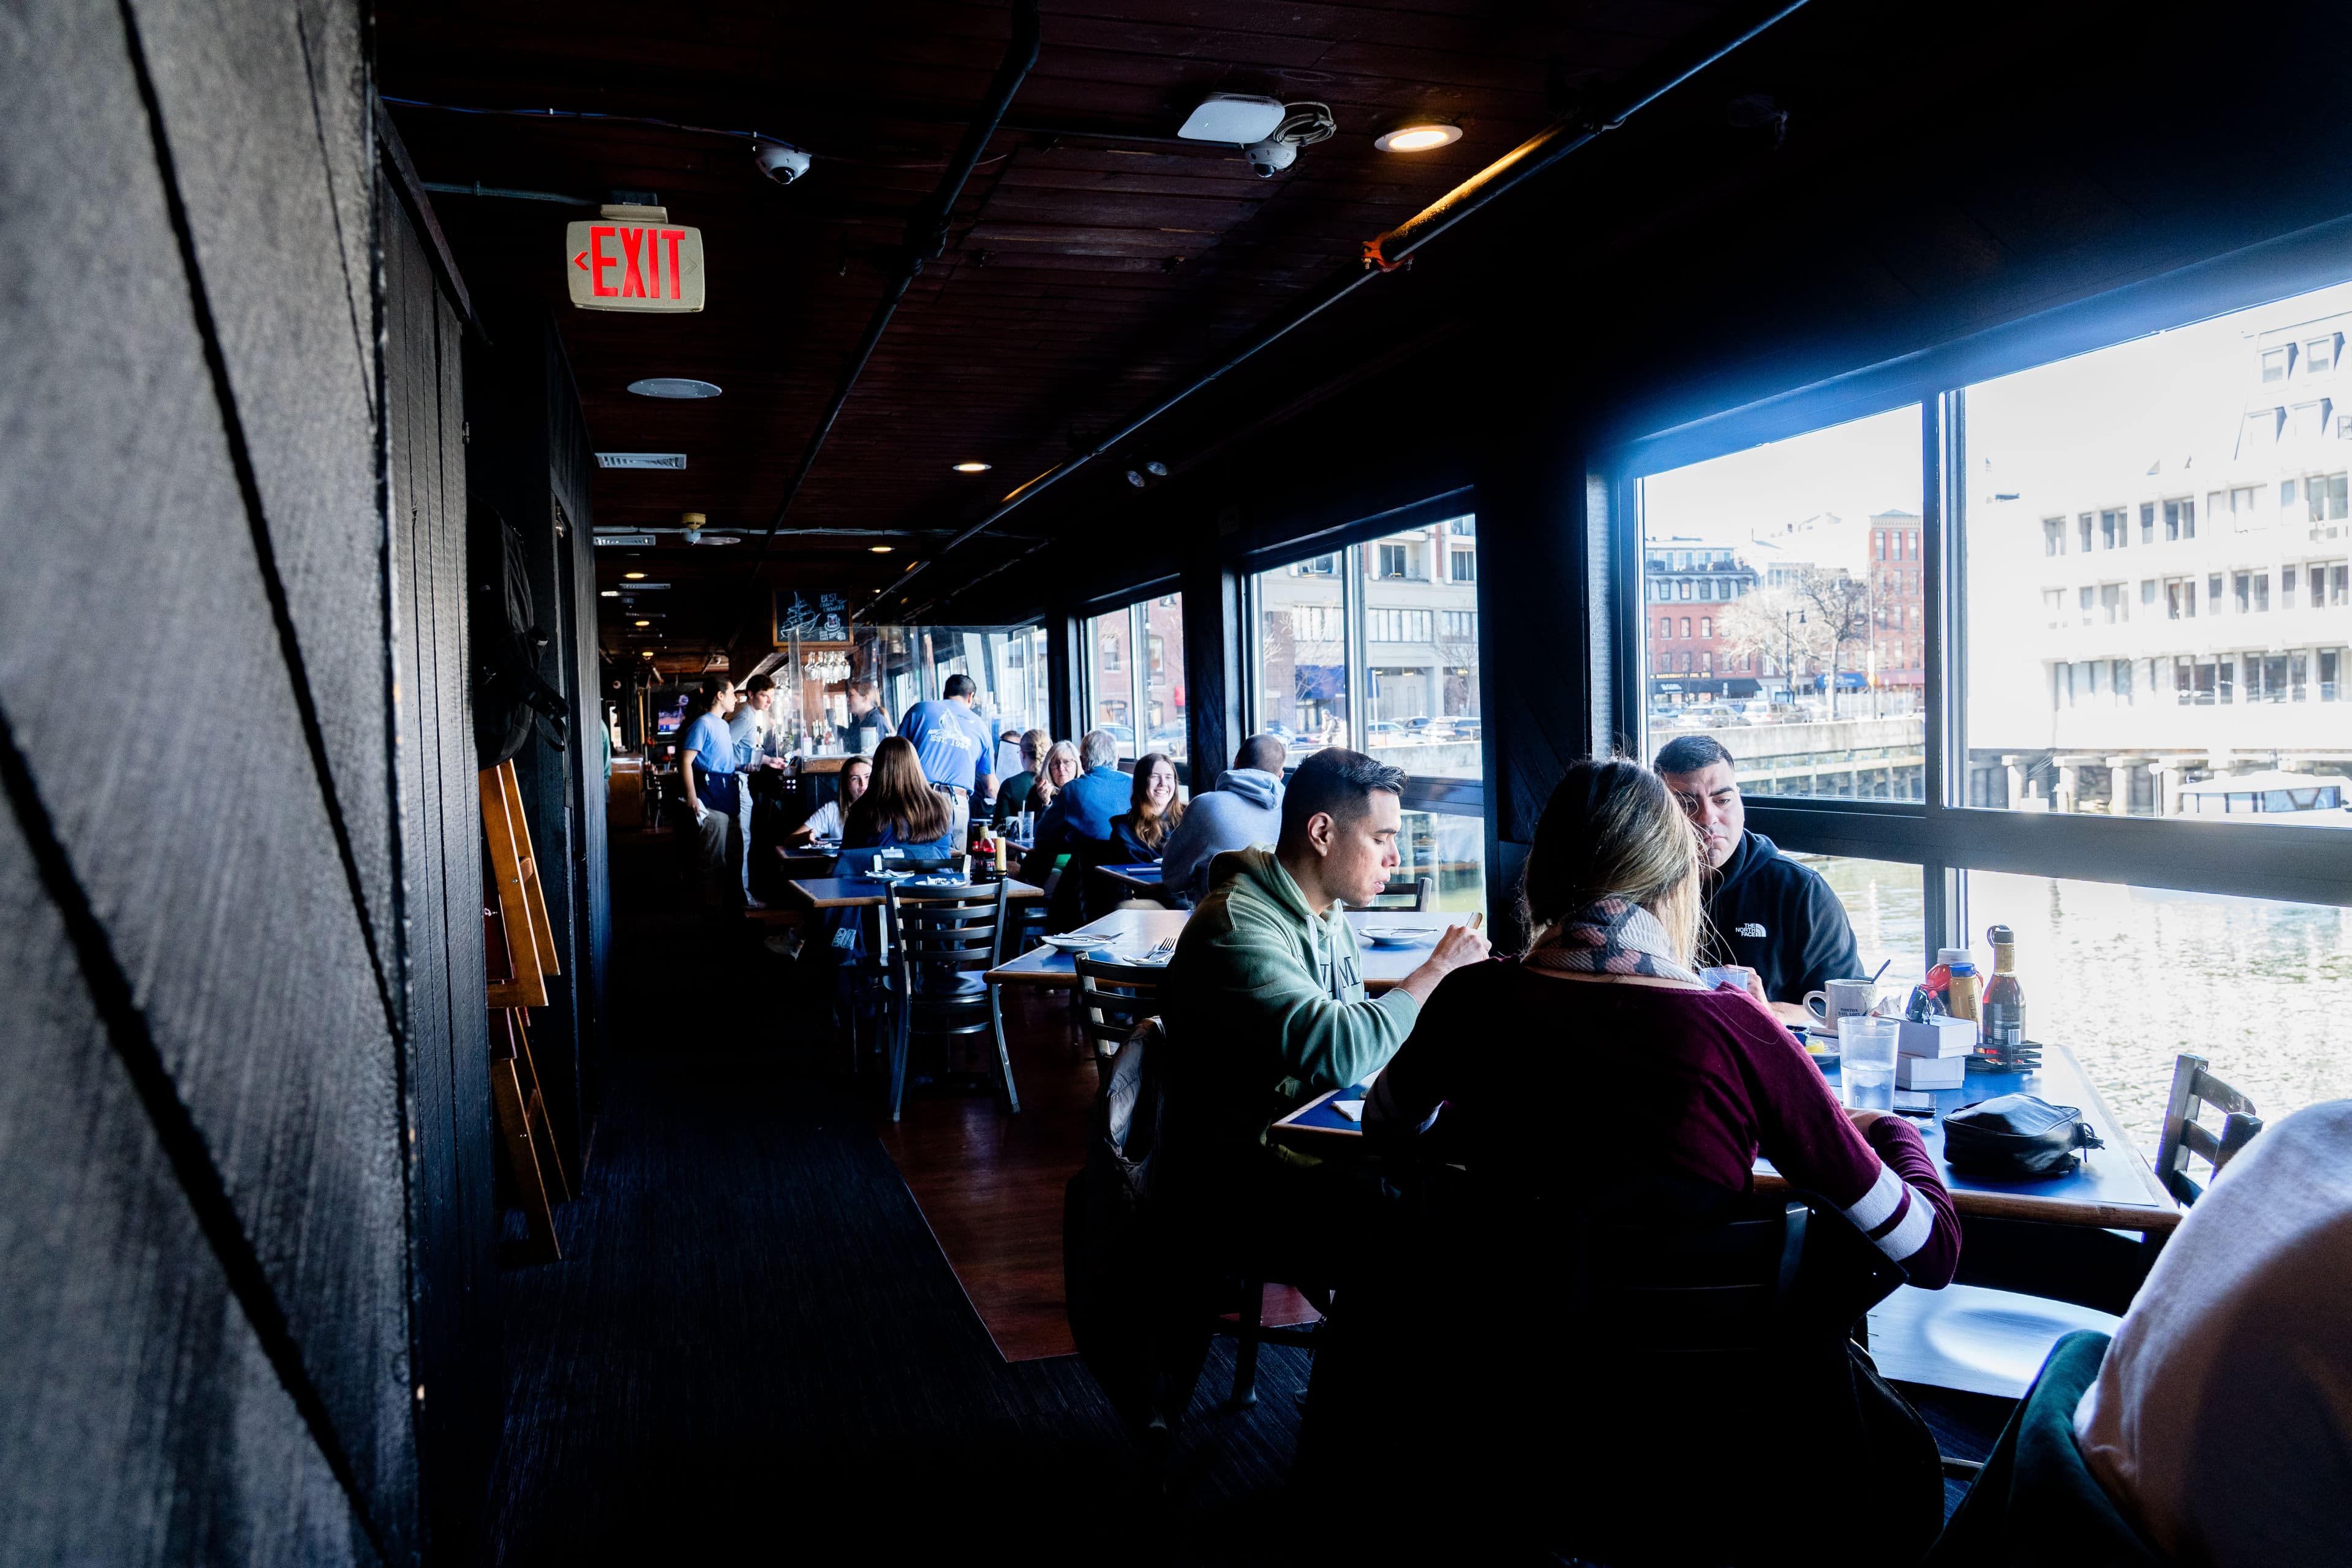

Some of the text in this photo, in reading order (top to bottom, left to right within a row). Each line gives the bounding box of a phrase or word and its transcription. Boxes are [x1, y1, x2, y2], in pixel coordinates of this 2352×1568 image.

[590, 226, 685, 300] EXIT
[821, 593, 838, 603] BEST
[930, 734, 948, 744] EST.
